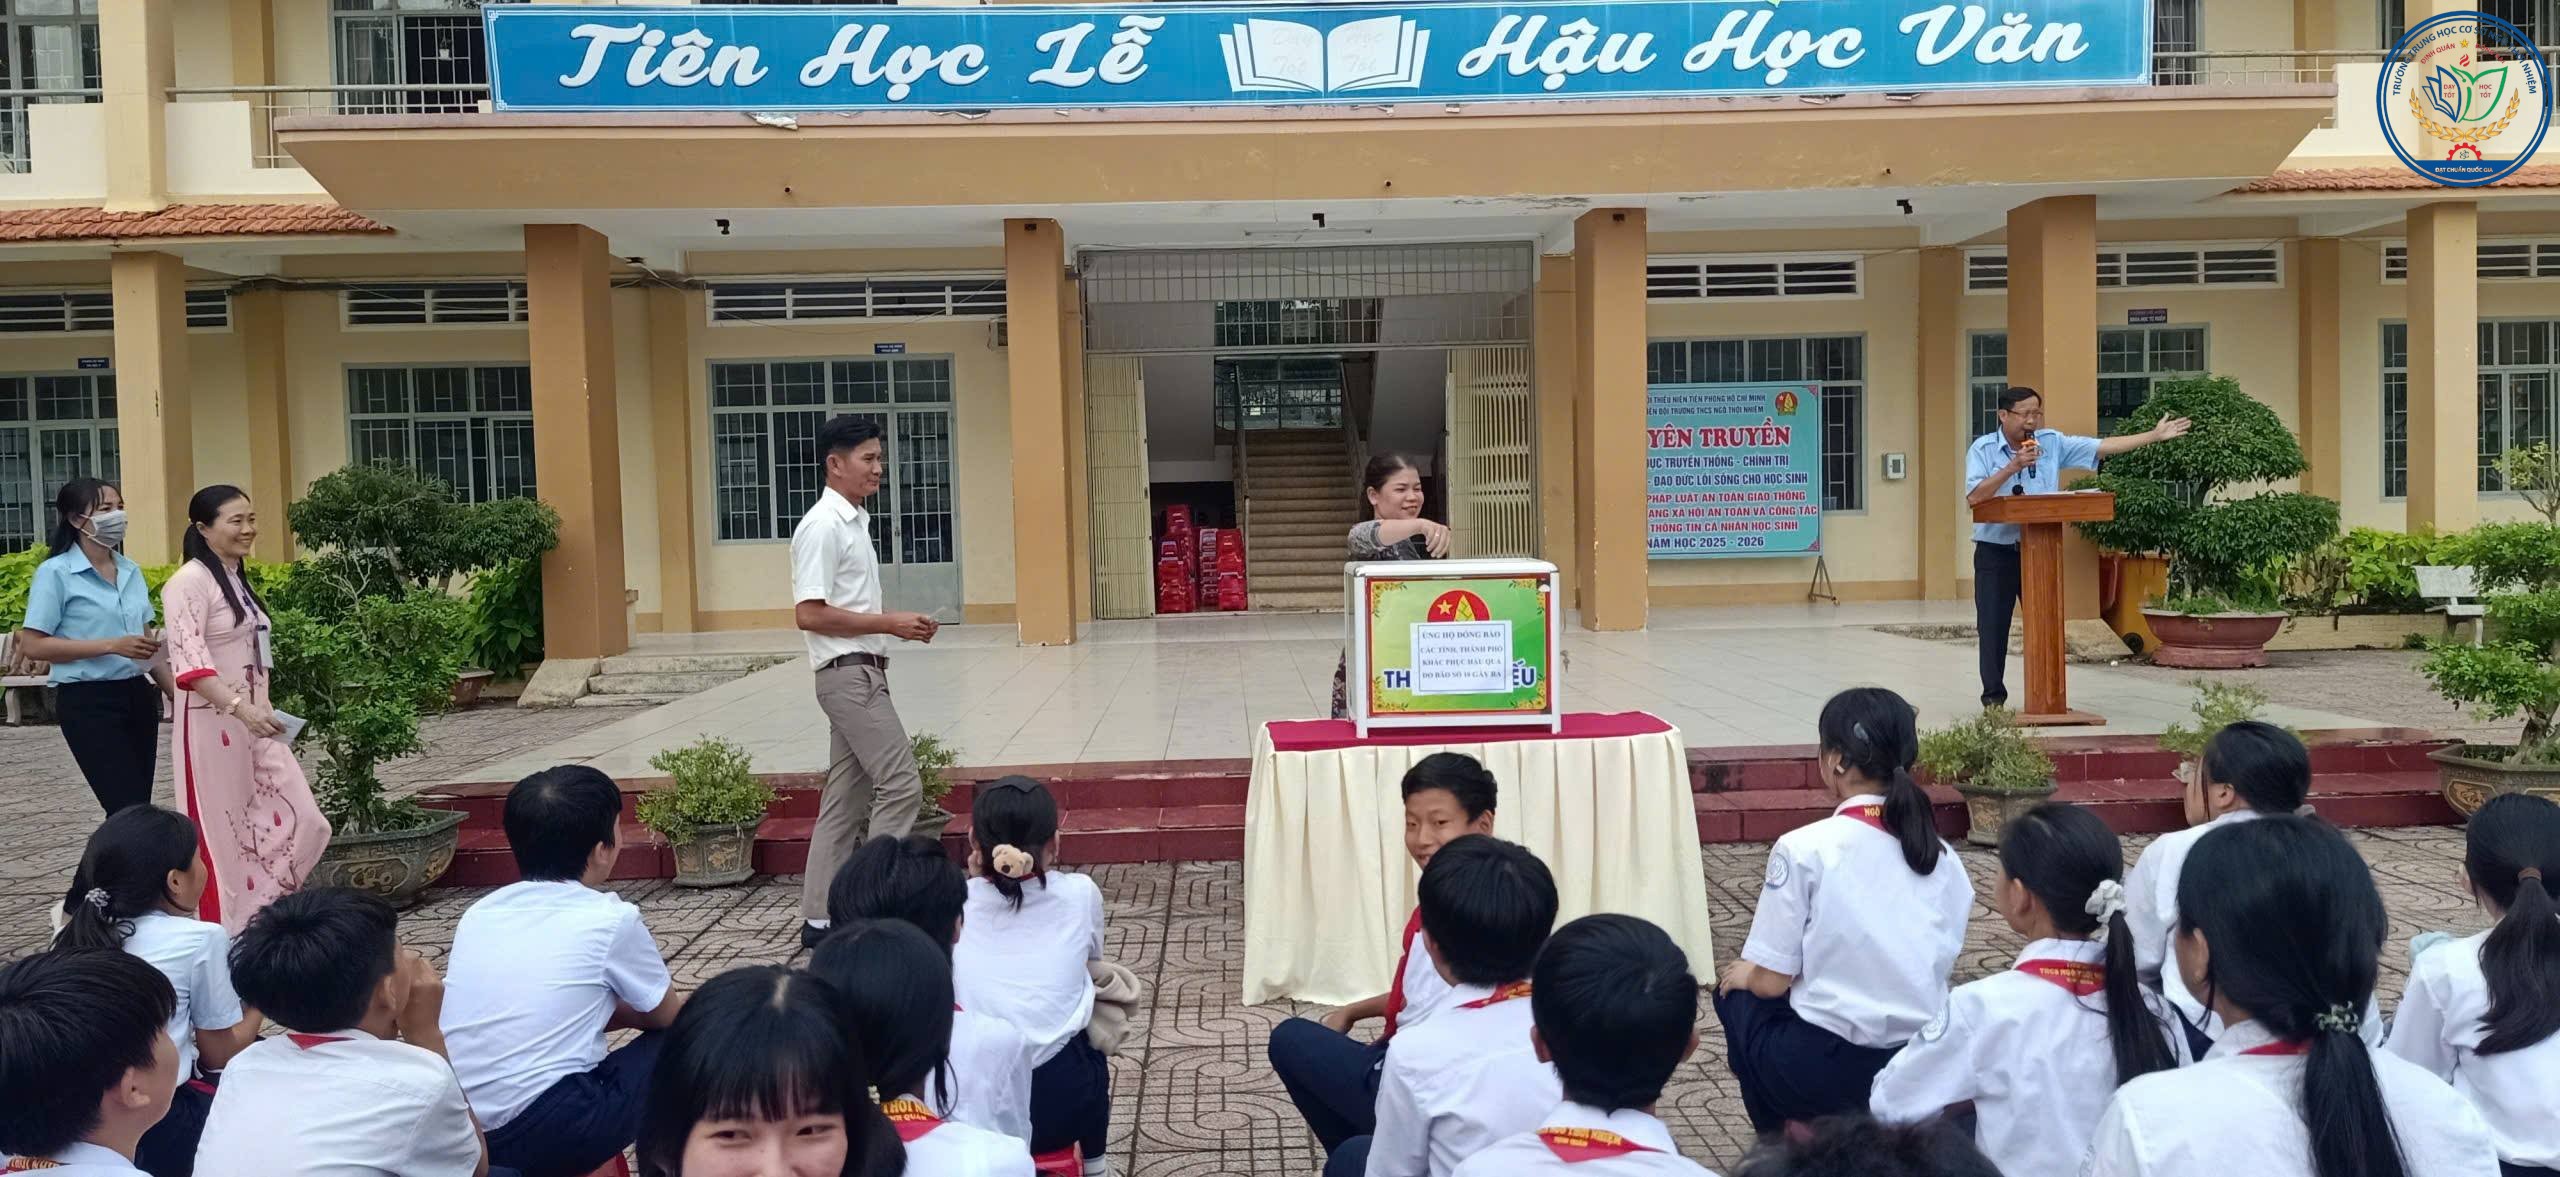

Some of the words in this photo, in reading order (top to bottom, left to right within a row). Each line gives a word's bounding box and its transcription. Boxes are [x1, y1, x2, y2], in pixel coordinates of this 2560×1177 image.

[1458, 14, 1657, 90] Hậu
[1683, 9, 1866, 85] Học
[1899, 4, 2089, 65] Văn
[560, 22, 769, 87] Tiên
[800, 23, 989, 101] Học
[1028, 14, 1166, 87] Lễ
[1749, 394, 1766, 402] MINH
[1697, 406, 1712, 414] THCS
[1648, 424, 1692, 448] YÊN
[1699, 417, 1791, 447] TRUYỀN
[1743, 454, 1772, 467] CHÍNH
[1775, 455, 1789, 469] TRỊ
[1654, 474, 1673, 487] ĐẠO
[1742, 474, 1761, 485] CHO
[1764, 474, 1782, 487] HỌC
[1785, 472, 1808, 484] SINH
[1702, 493, 1715, 502] AN
[1747, 492, 1771, 502] GIAO
[1774, 490, 1806, 501] THÔNG
[1708, 508, 1721, 517] AN
[1769, 505, 1796, 516] CÔNG
[1651, 522, 1683, 533] THÔNG
[1686, 523, 1701, 532] TIN
[1721, 521, 1748, 532] NHÂN
[1751, 522, 1771, 533] HỌC
[1774, 520, 1798, 531] SINH
[1674, 537, 1697, 550] HỌC
[1700, 537, 1727, 548] 2025
[1737, 536, 1764, 547] 2026
